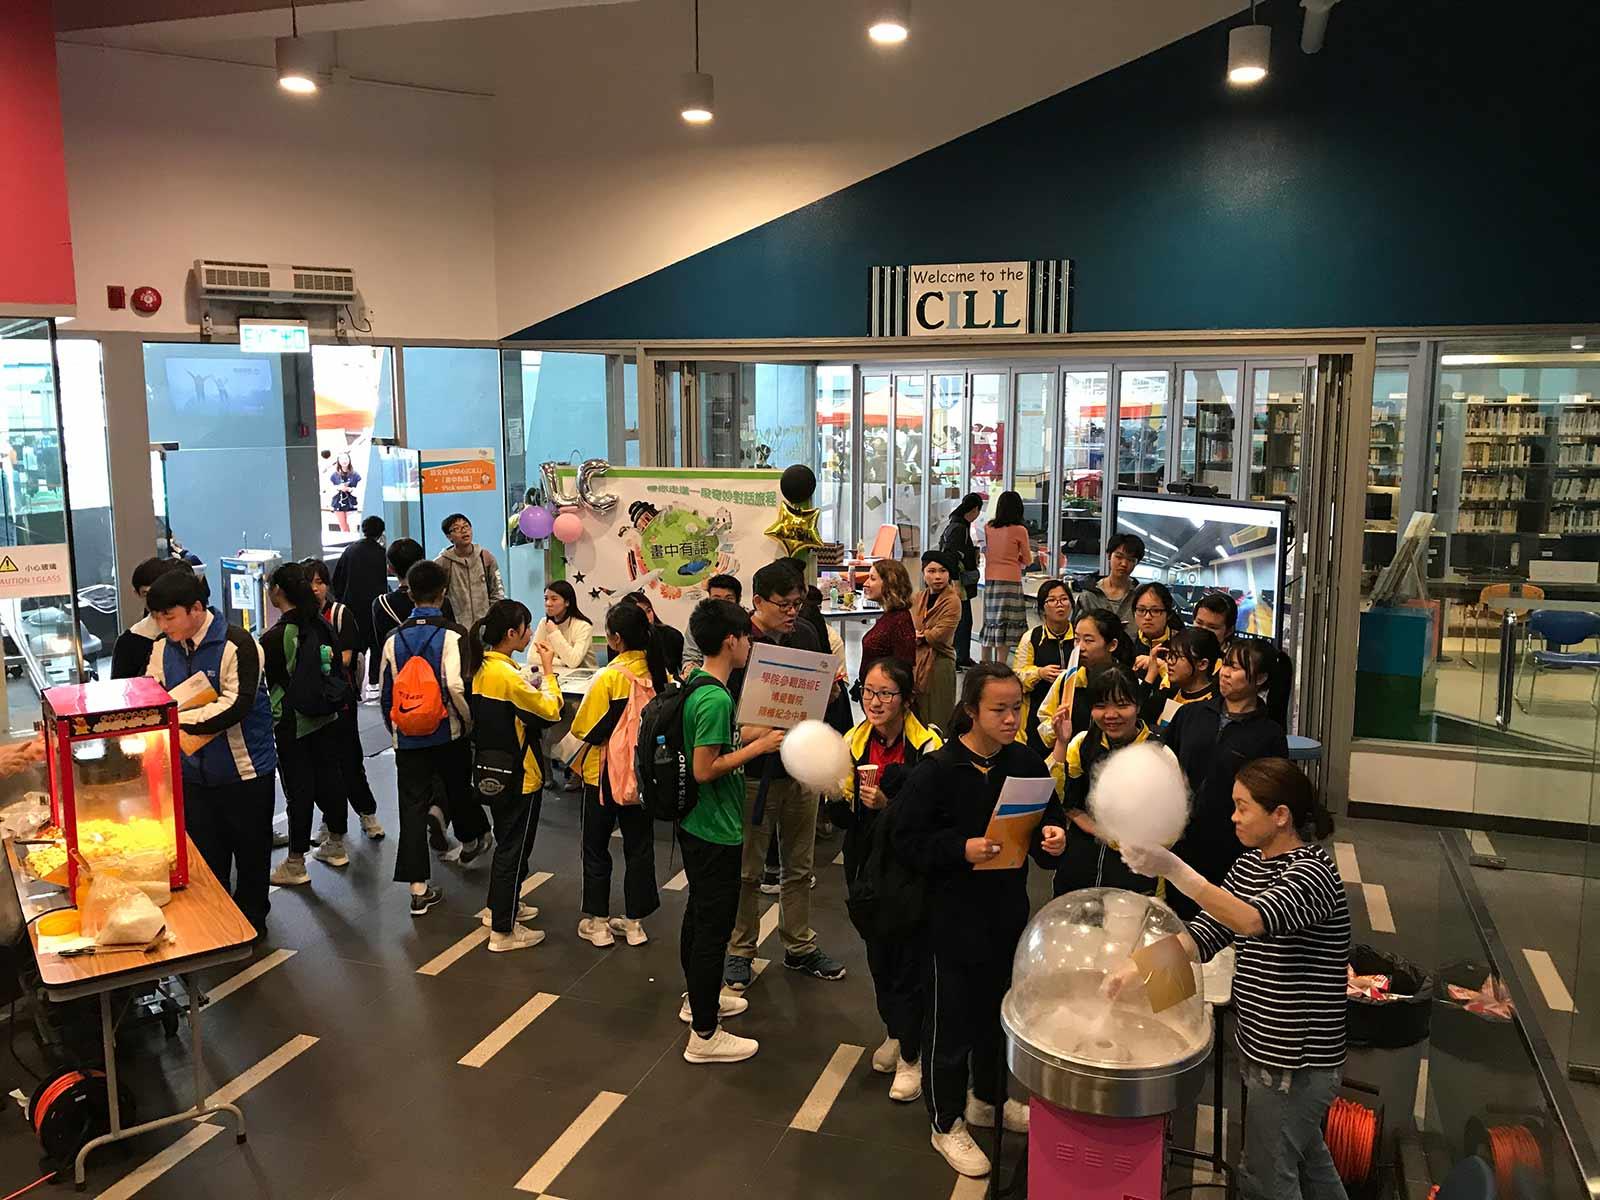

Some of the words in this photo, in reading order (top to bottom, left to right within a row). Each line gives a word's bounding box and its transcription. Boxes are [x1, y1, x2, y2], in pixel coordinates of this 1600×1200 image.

[913, 270, 975, 284] Welcome
[980, 269, 995, 282] to
[1000, 267, 1024, 281] the
[915, 289, 1021, 330] CILL
[25, 563, 57, 572] 小心玻璃
